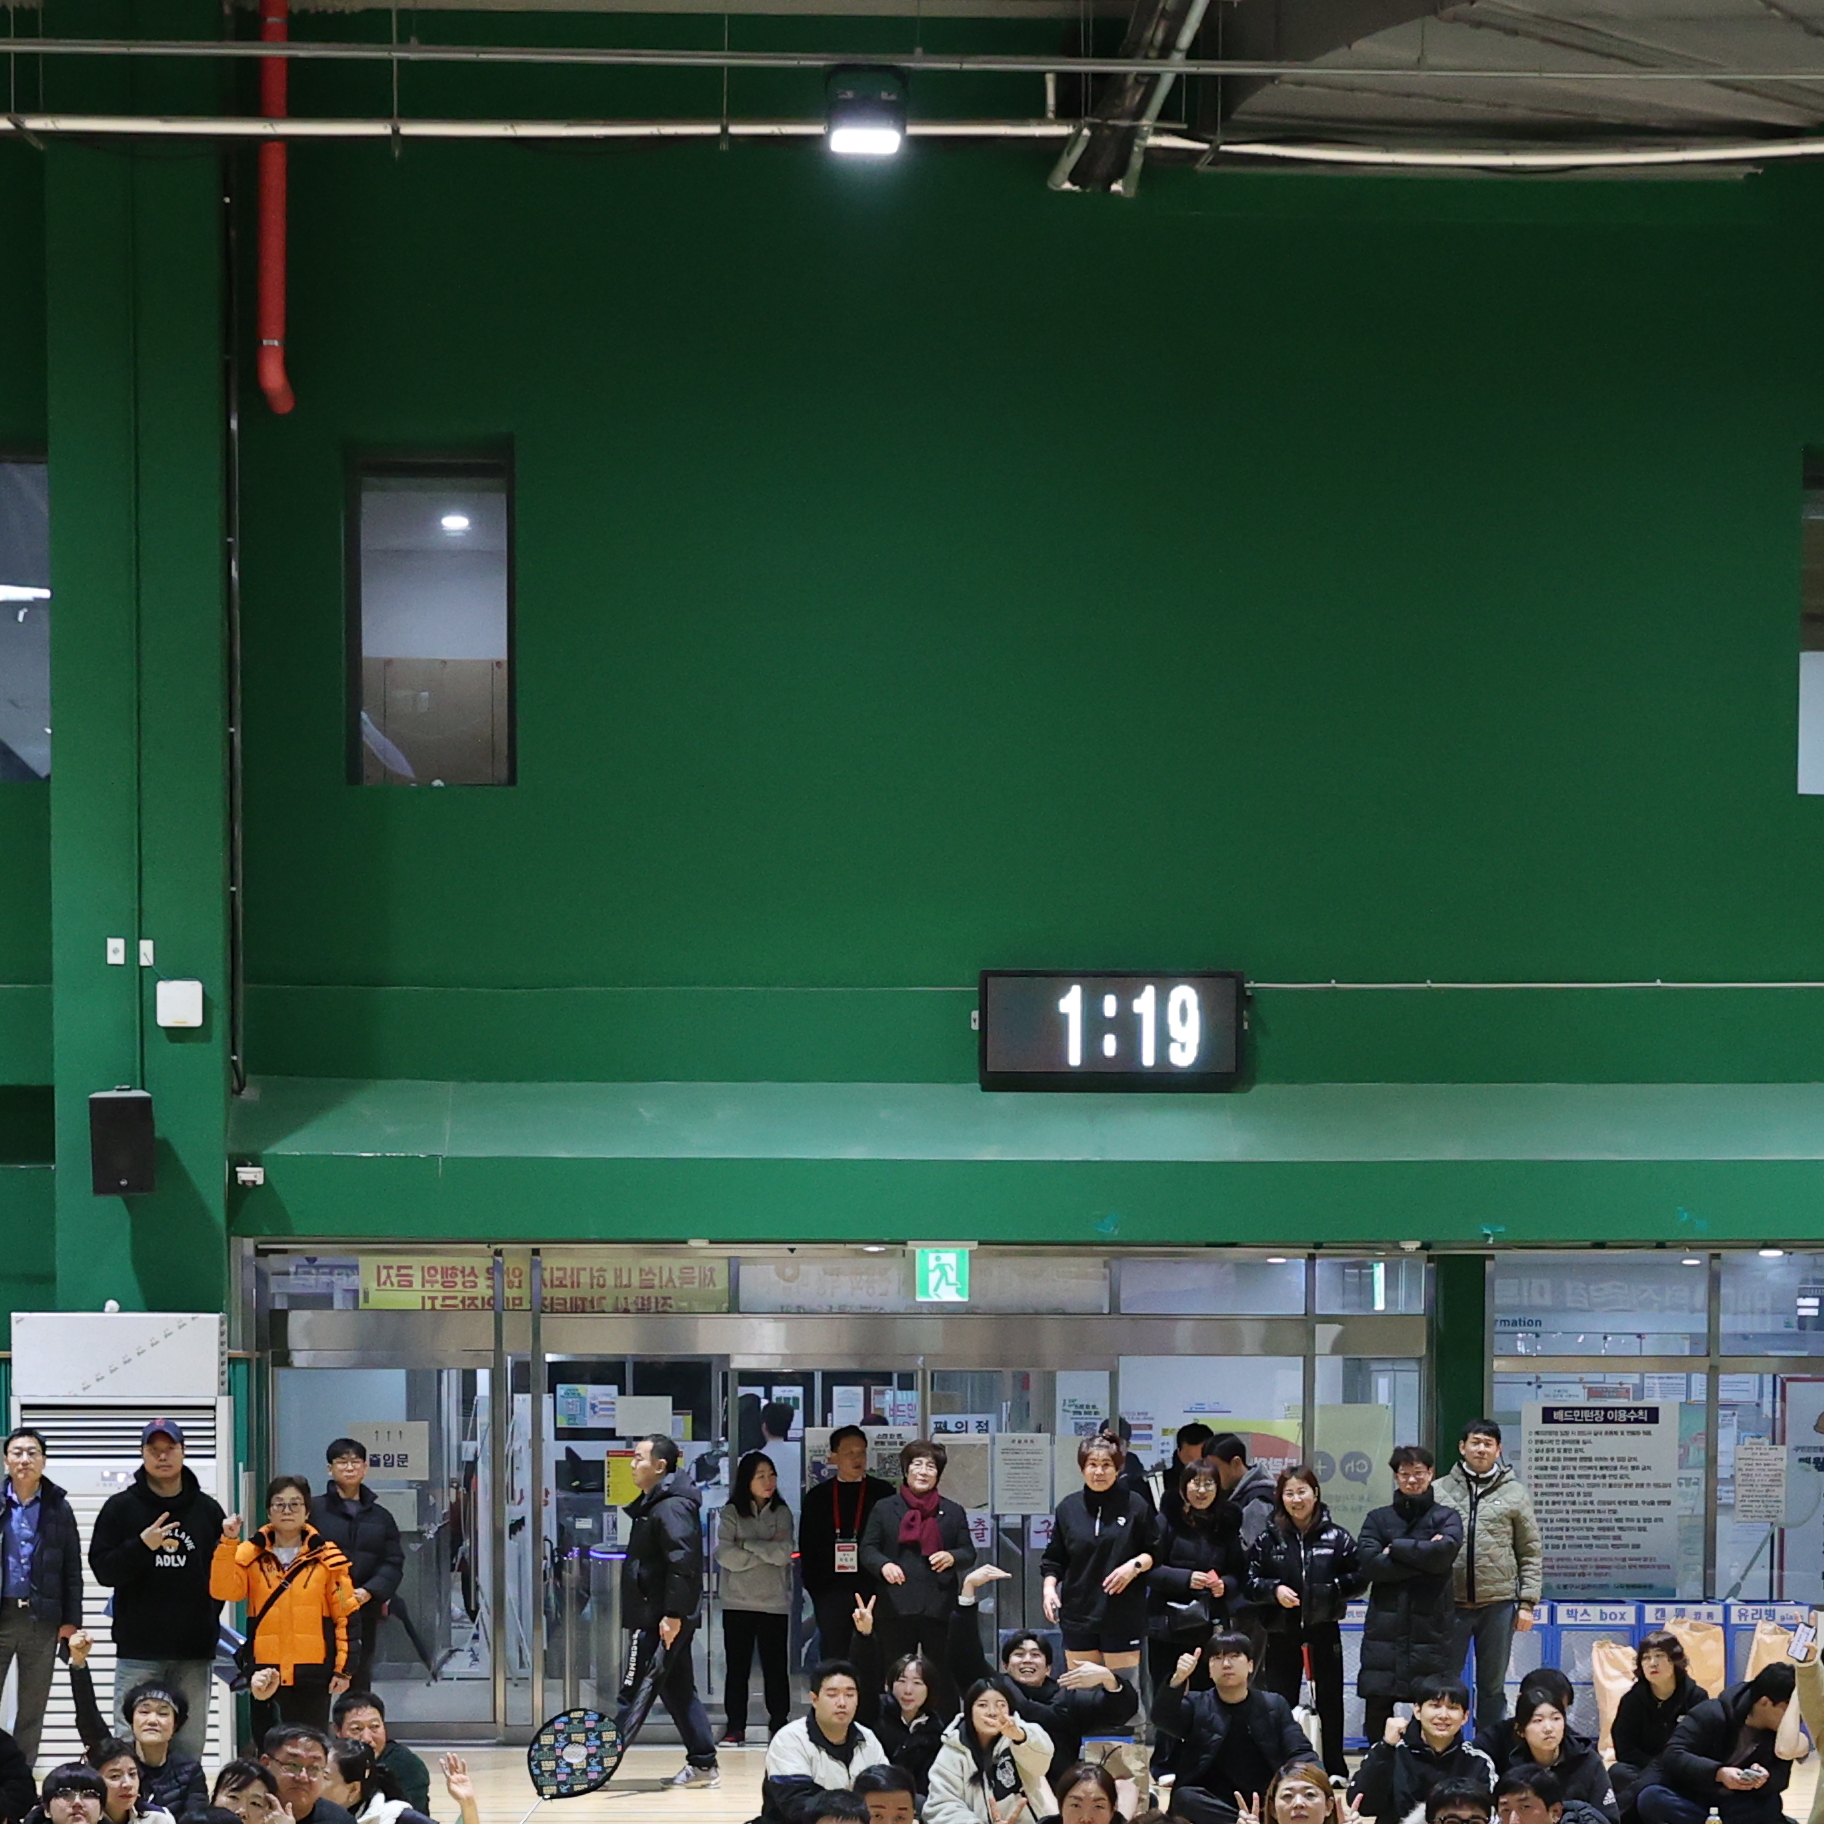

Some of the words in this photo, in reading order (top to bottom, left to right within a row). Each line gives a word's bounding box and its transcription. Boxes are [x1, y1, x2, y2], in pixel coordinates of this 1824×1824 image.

[1059, 984, 1200, 1067] 1:19
[1553, 1409, 1605, 1422] 배드민턴장
[1607, 1409, 1648, 1422] 이용수칙
[155, 1554, 187, 1568] ADLV
[1566, 1608, 1591, 1622] 박스
[1599, 1608, 1627, 1622] box
[1737, 1608, 1776, 1622] 유리병
